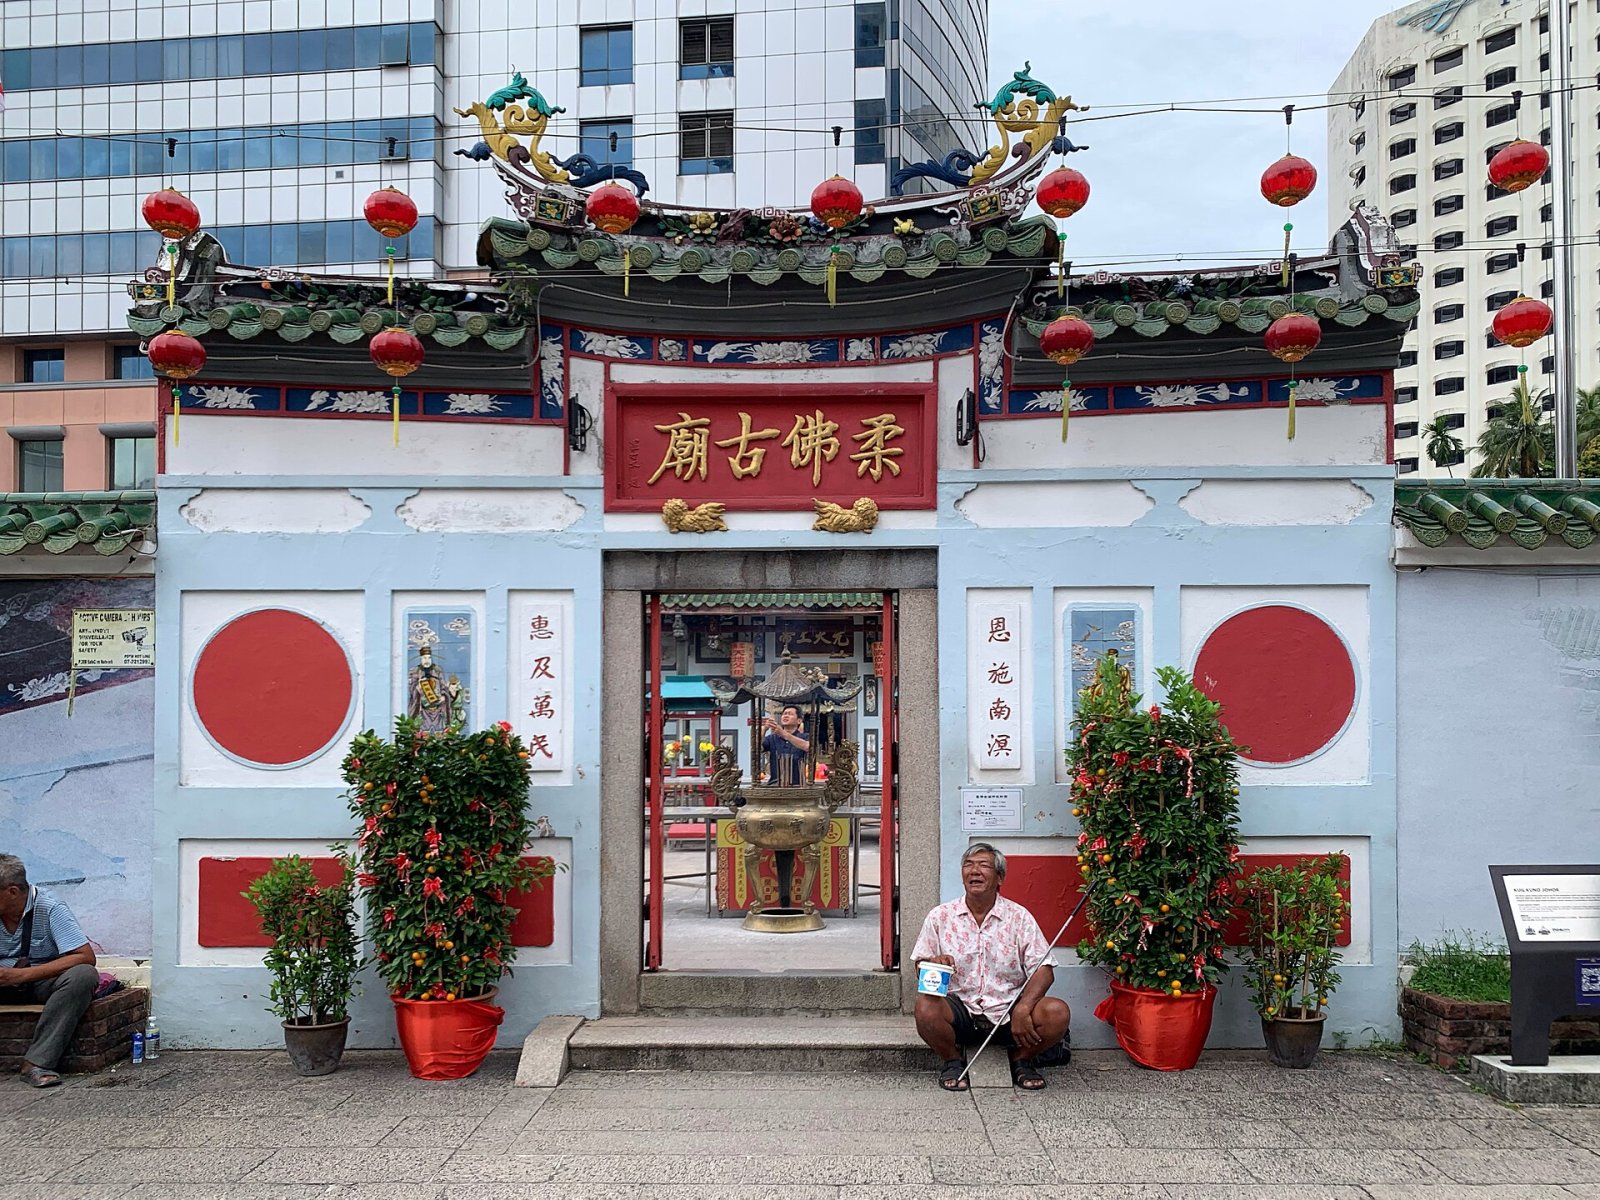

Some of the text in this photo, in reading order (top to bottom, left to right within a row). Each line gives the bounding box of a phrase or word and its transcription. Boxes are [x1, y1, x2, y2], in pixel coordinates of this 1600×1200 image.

[99, 613, 123, 622] CAMERA
[529, 615, 555, 759] 惠及萬民
[987, 616, 1013, 757] 恩施南溟
